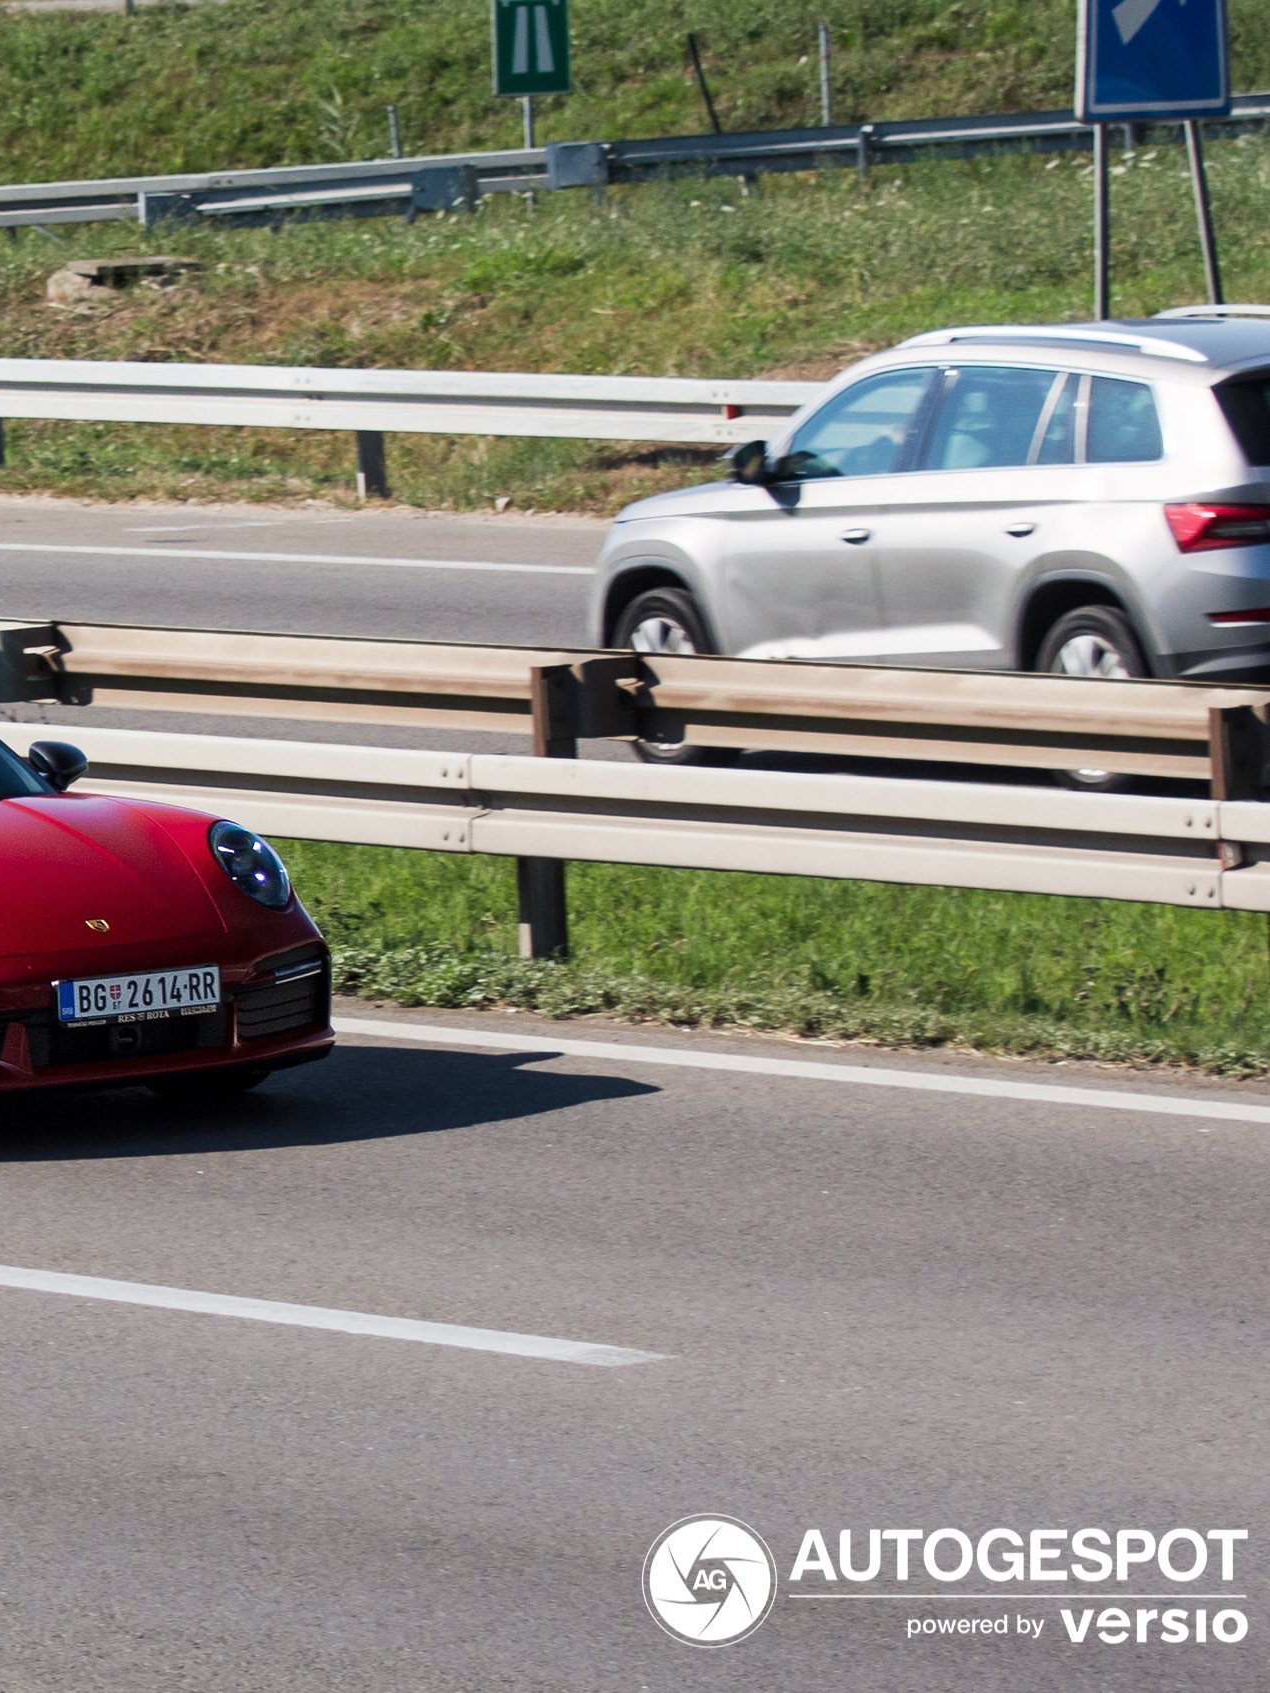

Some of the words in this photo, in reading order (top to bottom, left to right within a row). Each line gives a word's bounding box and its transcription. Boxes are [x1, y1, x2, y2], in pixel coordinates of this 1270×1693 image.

[78, 983, 107, 1013] BG
[117, 1013, 136, 1023] RES
[146, 1010, 170, 1021] ROTA
